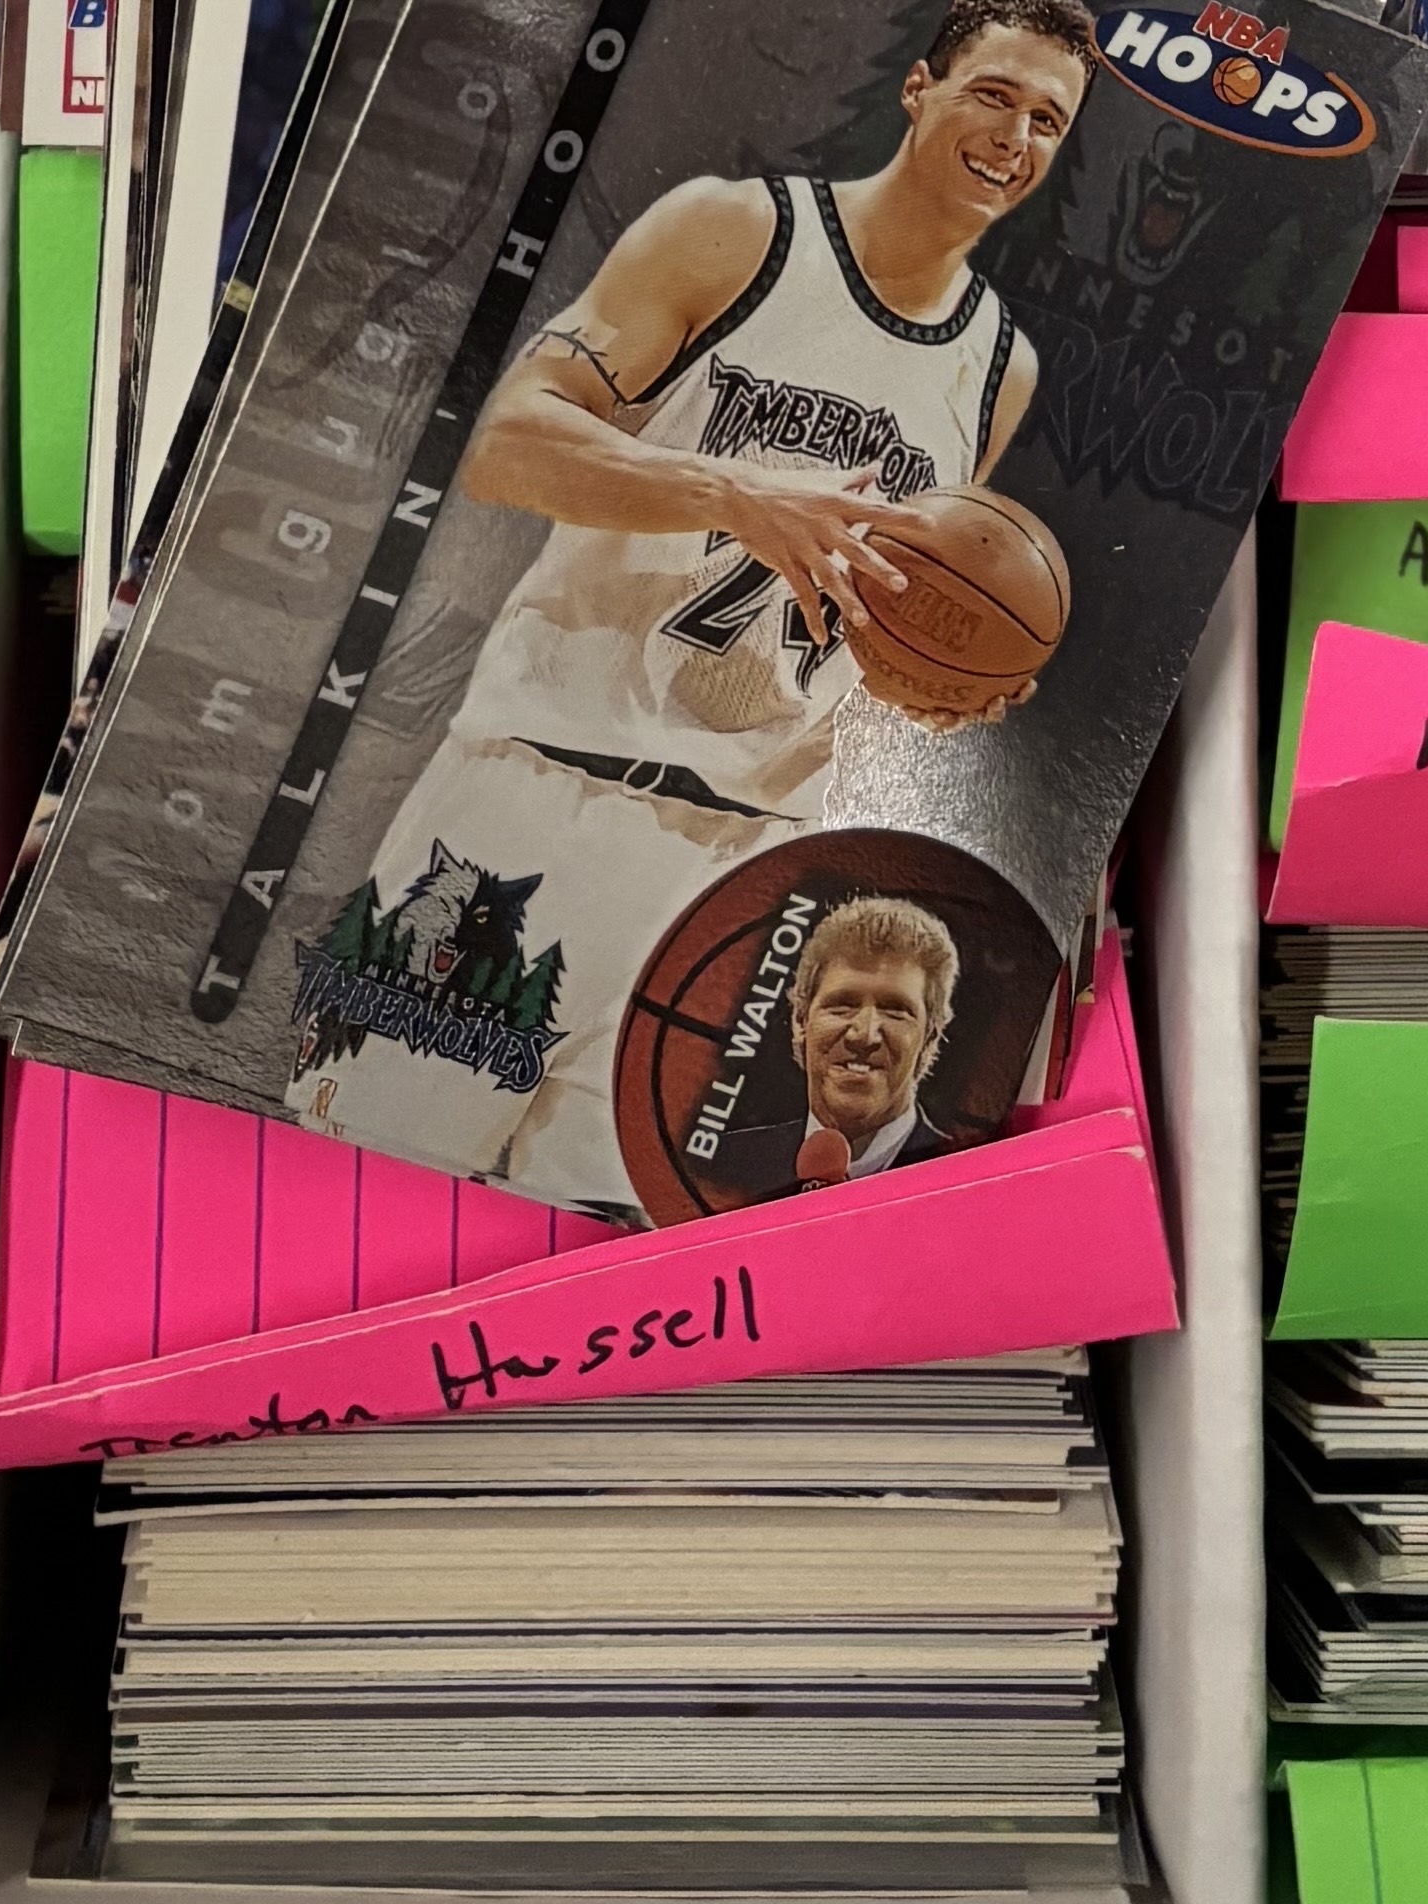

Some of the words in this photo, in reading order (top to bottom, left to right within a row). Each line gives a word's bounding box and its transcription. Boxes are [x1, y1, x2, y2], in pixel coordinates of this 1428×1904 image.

[1193, 0, 1289, 66] NBA
[290, 936, 574, 1094] TIMBERWOLVES
[685, 1073, 746, 1161] BILL
[723, 892, 818, 1060] WALTON
[430, 1265, 762, 1411] Hassell
